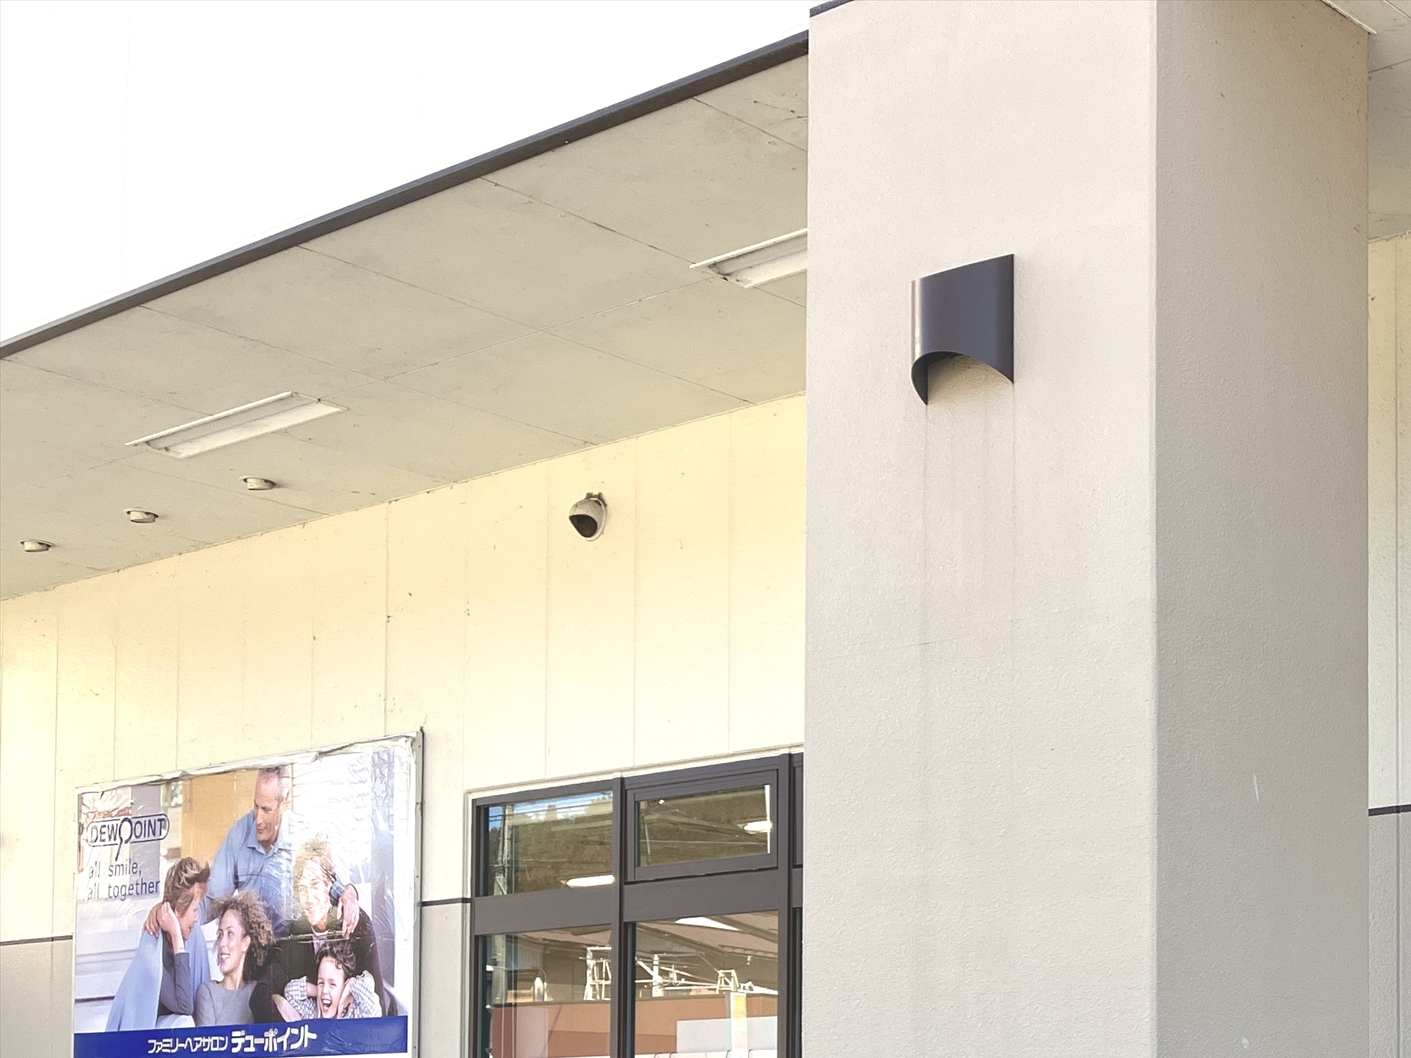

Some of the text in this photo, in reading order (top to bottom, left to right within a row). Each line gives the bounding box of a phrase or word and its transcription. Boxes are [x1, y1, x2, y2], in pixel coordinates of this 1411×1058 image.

[108, 858, 142, 878] smile,
[108, 878, 161, 902] together
[147, 1024, 318, 1054] ファミリーヘアサロン デューポイント
